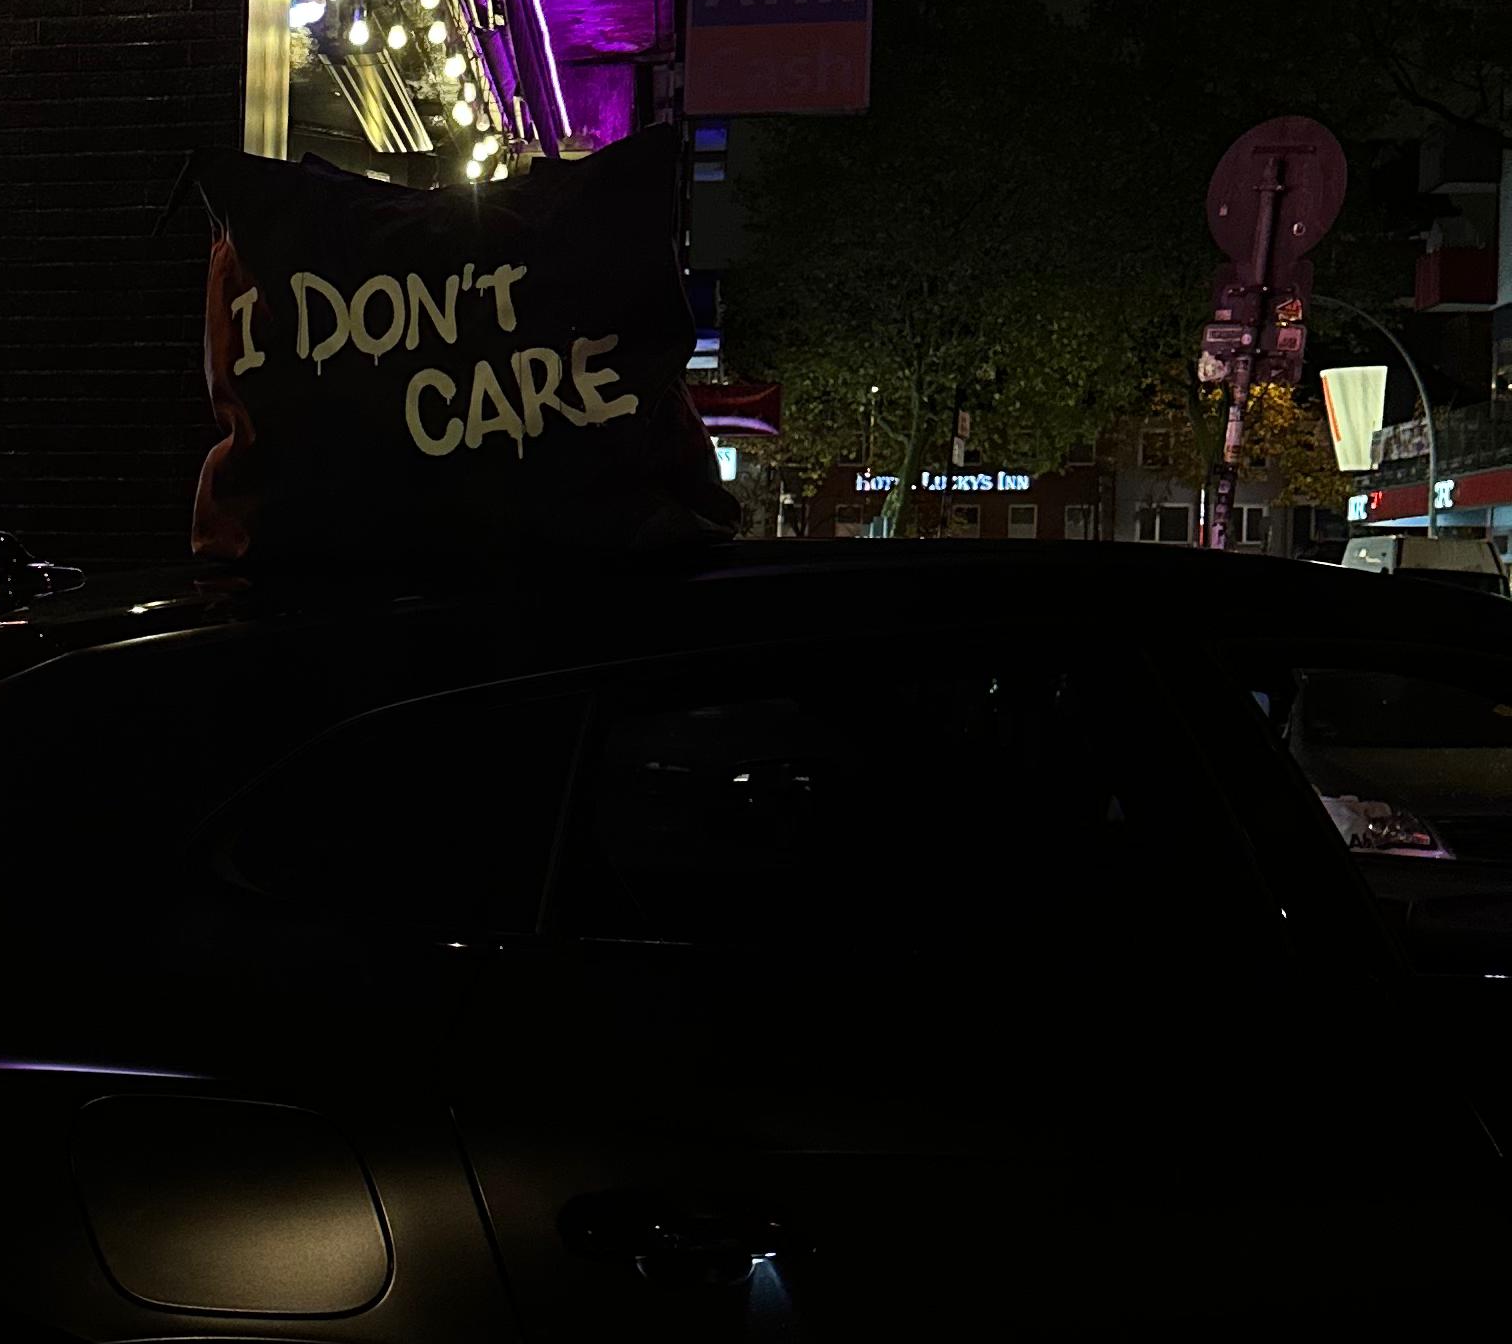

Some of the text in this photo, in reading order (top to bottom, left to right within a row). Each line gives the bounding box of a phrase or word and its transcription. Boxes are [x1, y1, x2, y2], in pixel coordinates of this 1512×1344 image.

[231, 263, 528, 376] I DON'T
[403, 333, 640, 459] CARE
